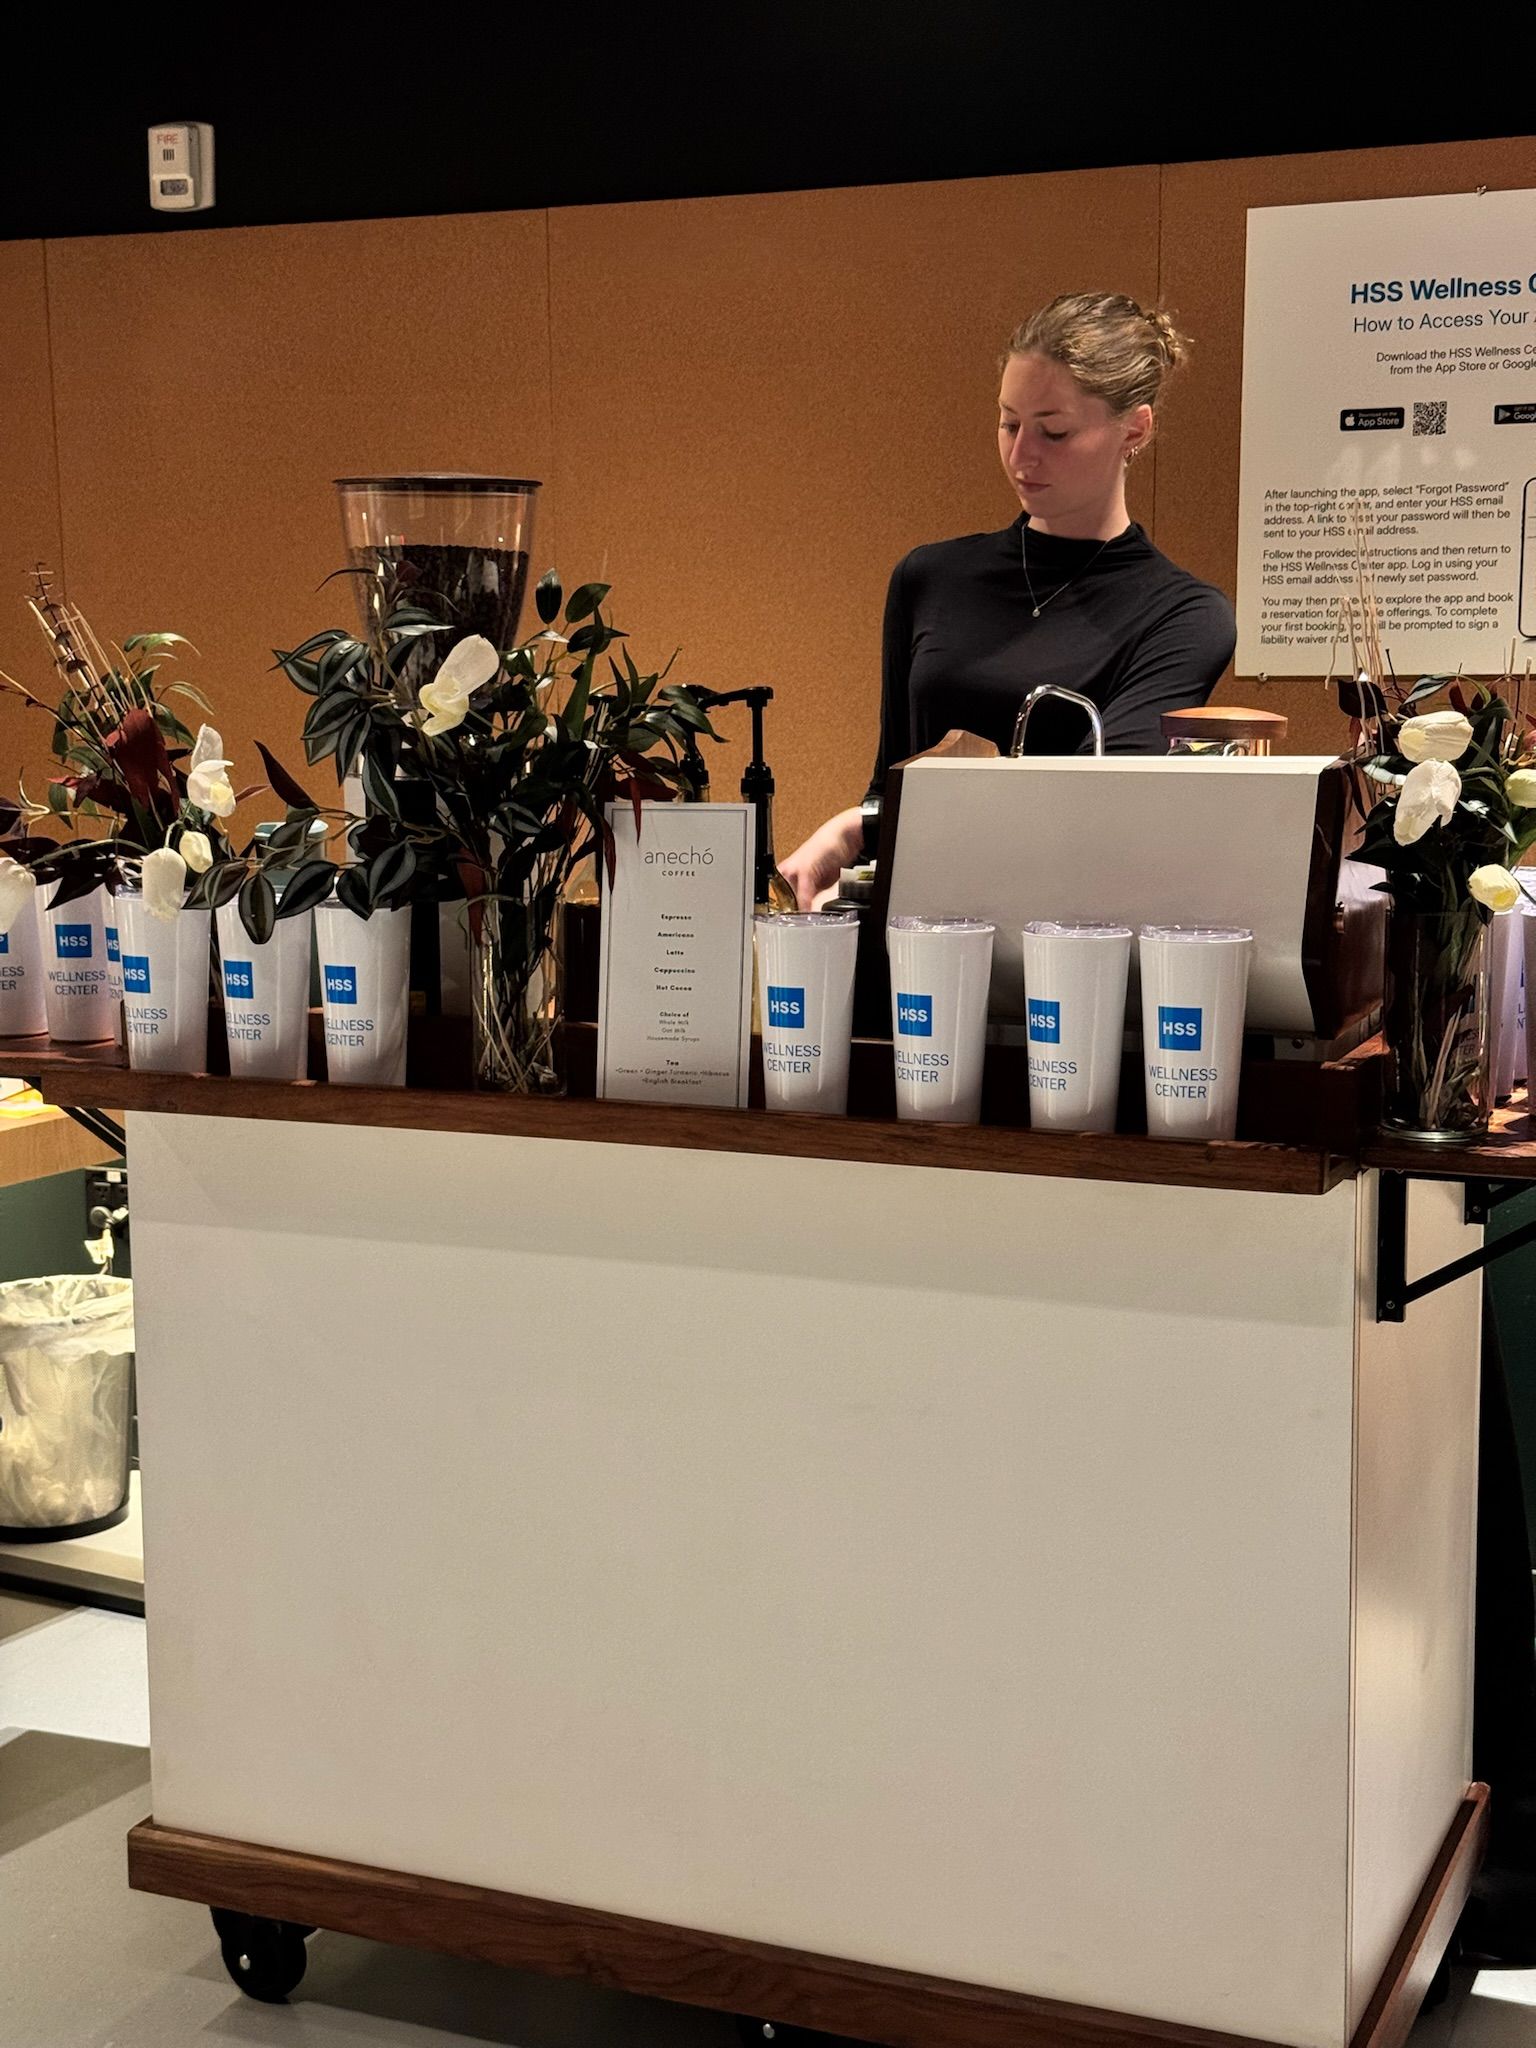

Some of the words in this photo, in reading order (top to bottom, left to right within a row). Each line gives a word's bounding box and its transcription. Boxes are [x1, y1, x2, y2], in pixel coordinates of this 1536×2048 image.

[157, 134, 179, 144] FIRE
[1351, 281, 1403, 304] HSS
[1410, 277, 1521, 301] Wellness
[1353, 317, 1393, 333] How
[1399, 316, 1414, 331] to
[1419, 313, 1483, 329] Access
[1489, 309, 1529, 325] Your
[1376, 350, 1427, 362] Download
[1430, 348, 1446, 360] the
[1449, 347, 1472, 359] HSS
[1475, 345, 1521, 357] Wellness
[1390, 365, 1413, 375] from
[1416, 363, 1432, 374] the
[1435, 362, 1456, 375] App
[1459, 361, 1486, 372] Store
[1489, 361, 1500, 370] or
[1358, 418, 1376, 428] App
[1376, 417, 1400, 426] Store
[1513, 411, 1536, 421] Goog
[1264, 489, 1288, 499] After
[1291, 488, 1337, 499] launching
[1340, 488, 1356, 497] the
[1359, 488, 1380, 498] app,
[1383, 486, 1413, 496] select
[1264, 503, 1273, 512] in
[1276, 502, 1291, 512] the
[1294, 501, 1336, 513] top-right
[1375, 499, 1394, 509] and
[1396, 499, 1422, 508] enter
[1425, 499, 1448, 510] your
[1450, 496, 1473, 506] HSS
[1476, 496, 1503, 506] email
[1264, 515, 1304, 525] address.
[1307, 515, 1315, 523] A
[1317, 514, 1334, 523] link
[1337, 514, 1346, 523] to
[1376, 512, 1398, 524] your
[1401, 511, 1450, 523] password
[1452, 510, 1469, 520] will
[1472, 509, 1494, 519] then
[1497, 509, 1510, 518] be
[1264, 529, 1284, 538] sent
[1287, 529, 1297, 537] to
[1299, 529, 1320, 540] your
[1323, 527, 1345, 537] HSS
[1377, 525, 1419, 535] address.
[1263, 549, 1294, 559] Follow
[1296, 548, 1312, 559] the
[1420, 546, 1439, 556] and
[1442, 546, 1465, 556] then
[1467, 546, 1498, 555] return
[1501, 545, 1511, 554] to
[1263, 563, 1278, 572] the
[1281, 562, 1302, 572] HSS
[1305, 561, 1348, 571] Wellness
[1387, 562, 1409, 572] app.
[1411, 559, 1431, 571] Log
[1434, 559, 1442, 569] in
[1445, 558, 1472, 570] using
[1475, 558, 1498, 569] your
[1262, 575, 1284, 585] HSS
[1286, 575, 1312, 585] email
[1377, 573, 1406, 584] newly
[1409, 573, 1424, 583] set
[1427, 571, 1478, 584] password.
[1262, 597, 1280, 606] You
[1282, 598, 1303, 608] may
[1306, 596, 1327, 606] then
[1385, 594, 1422, 605] explore
[1425, 593, 1441, 604] the
[1444, 595, 1463, 605] app
[1466, 593, 1485, 603] and
[1488, 592, 1513, 602] book
[1270, 609, 1323, 619] reservation
[1326, 608, 1339, 618] for
[1386, 607, 1432, 619] offerings.
[1435, 606, 1448, 616] To
[1450, 606, 1498, 617] complete
[1261, 623, 1282, 634] your
[1285, 622, 1303, 632] first
[1389, 620, 1401, 630] be
[1404, 620, 1453, 632] prompted
[1456, 620, 1465, 629] to
[1469, 620, 1489, 631] sign
[1492, 621, 1499, 629] a
[1261, 635, 1294, 646] liability
[1296, 635, 1328, 644] waiver
[644, 845, 714, 865] anechó
[661, 913, 692, 921] Espresso
[59, 936, 89, 947] HSS
[107, 939, 119, 951] HS
[48, 970, 106, 982] WELLNESS
[124, 968, 146, 981] HSS
[654, 966, 695, 975] Cappuccino
[226, 973, 249, 987] HSS
[327, 978, 353, 992] HSS
[55, 985, 99, 996] CENTER
[771, 1001, 800, 1015] HSS
[226, 1012, 271, 1026] ELLNESS
[900, 1008, 928, 1023] HSS
[1030, 1013, 1056, 1029] HSS
[128, 1022, 159, 1035] ENTER
[326, 1018, 374, 1031] ELLNESS
[1163, 1022, 1197, 1037] HSS
[227, 1028, 262, 1041] ENTER
[767, 1058, 812, 1074] CENTER
[895, 1051, 950, 1067] ELLNESS
[1028, 1057, 1078, 1074] ELLNESS
[897, 1067, 939, 1083] CENTER
[1149, 1065, 1218, 1081] WELLNESS
[1155, 1083, 1207, 1099] CENTER
